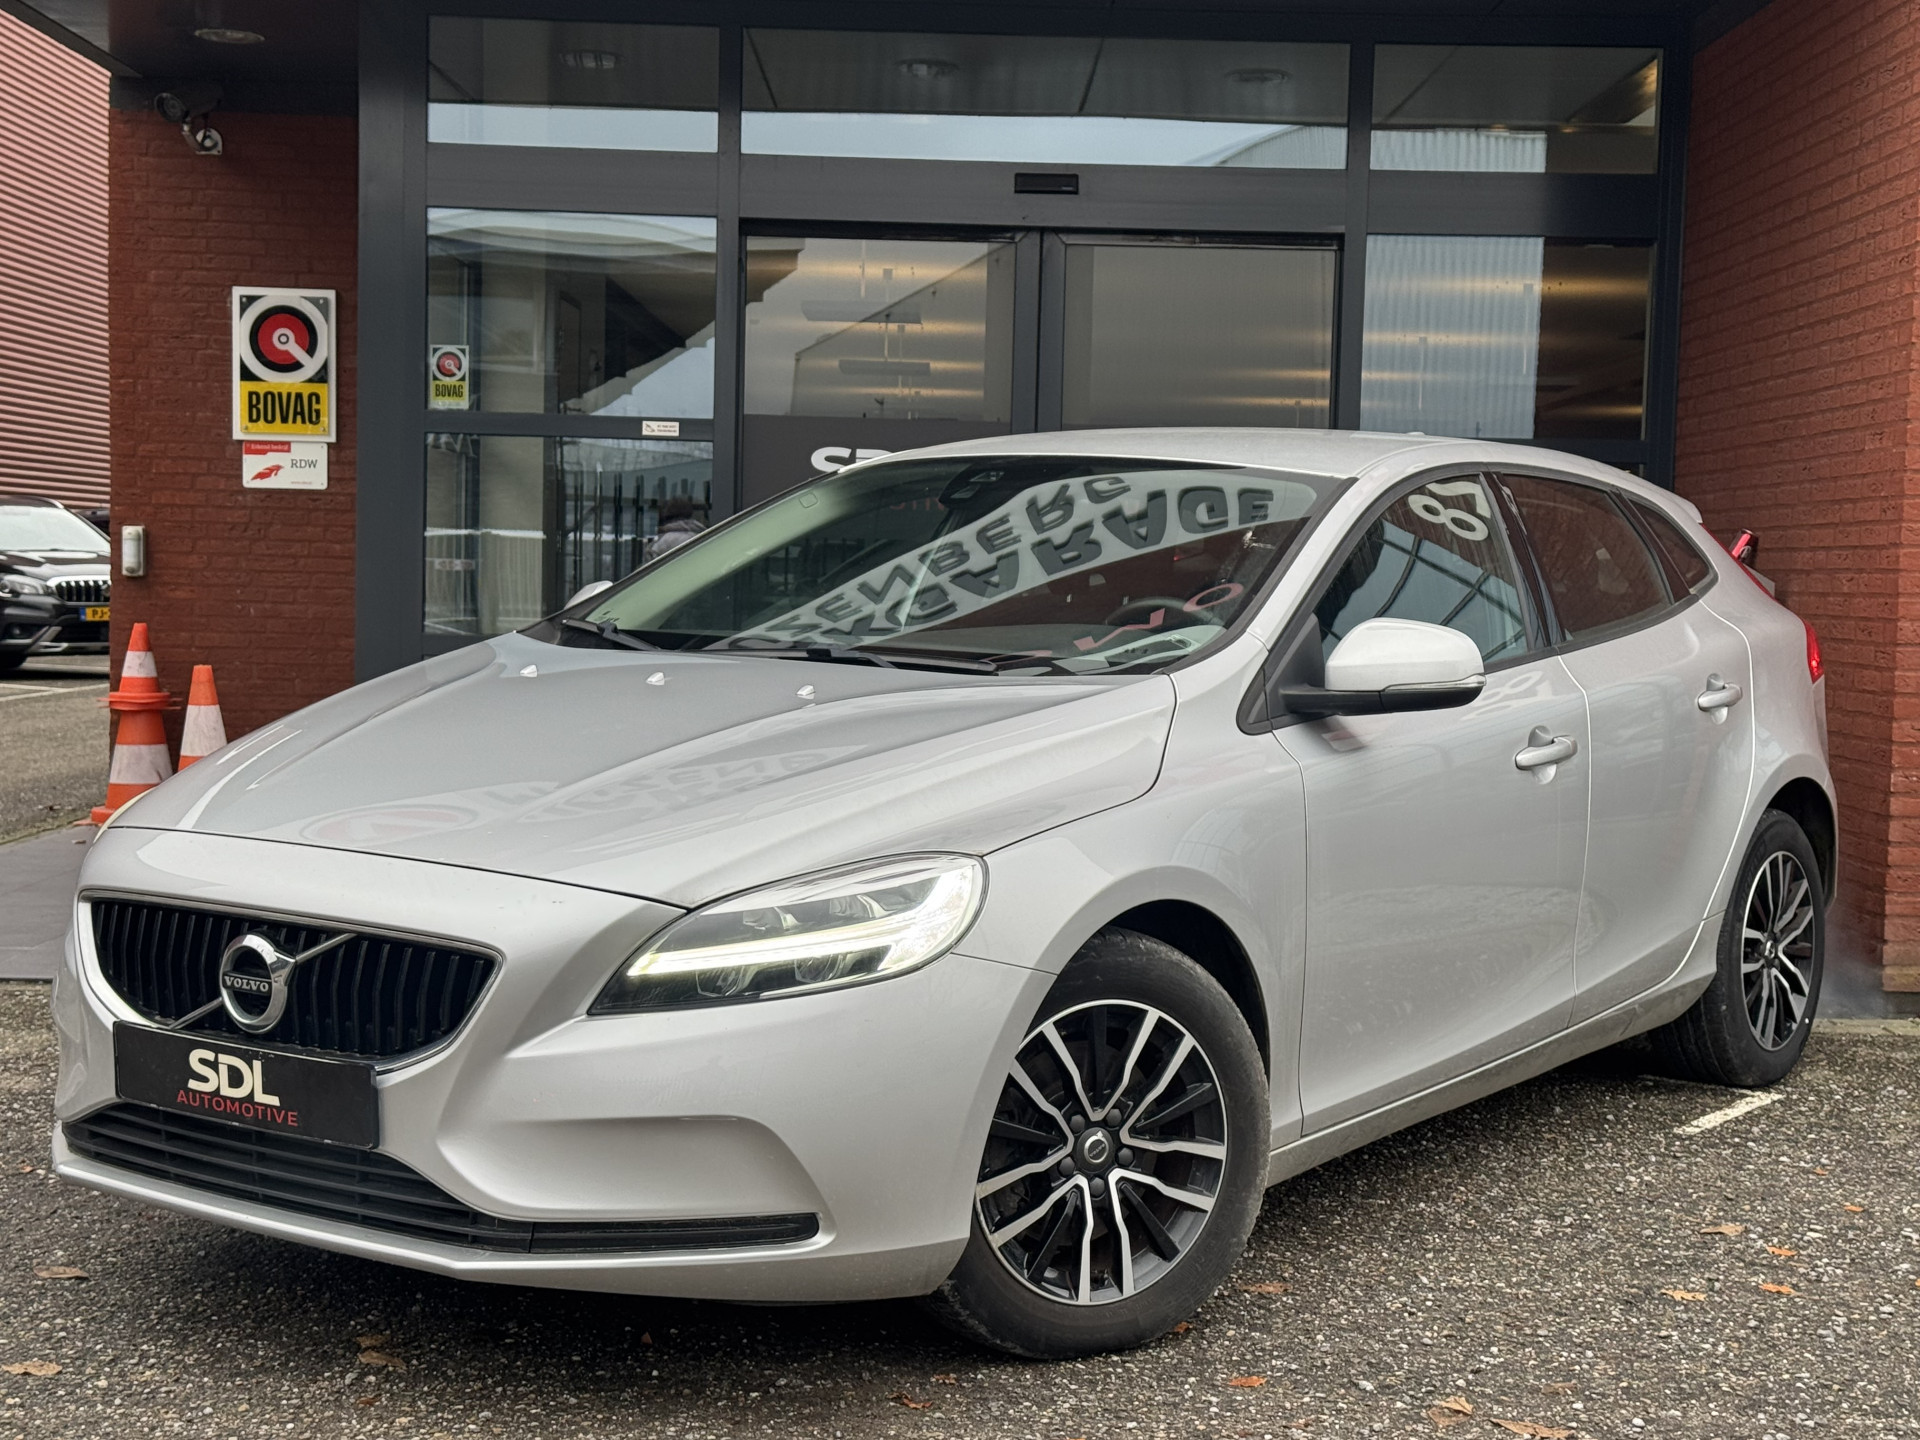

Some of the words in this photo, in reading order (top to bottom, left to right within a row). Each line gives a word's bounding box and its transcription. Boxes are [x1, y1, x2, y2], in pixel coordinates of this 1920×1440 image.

[435, 383, 464, 398] BOVAG
[247, 390, 321, 426] BOVAG
[290, 458, 319, 469] RDW
[92, 608, 110, 619] PJ-
[224, 975, 269, 992] VOLVO
[187, 1048, 281, 1107] SDL
[176, 1089, 298, 1127] AUTOMOTIVE
